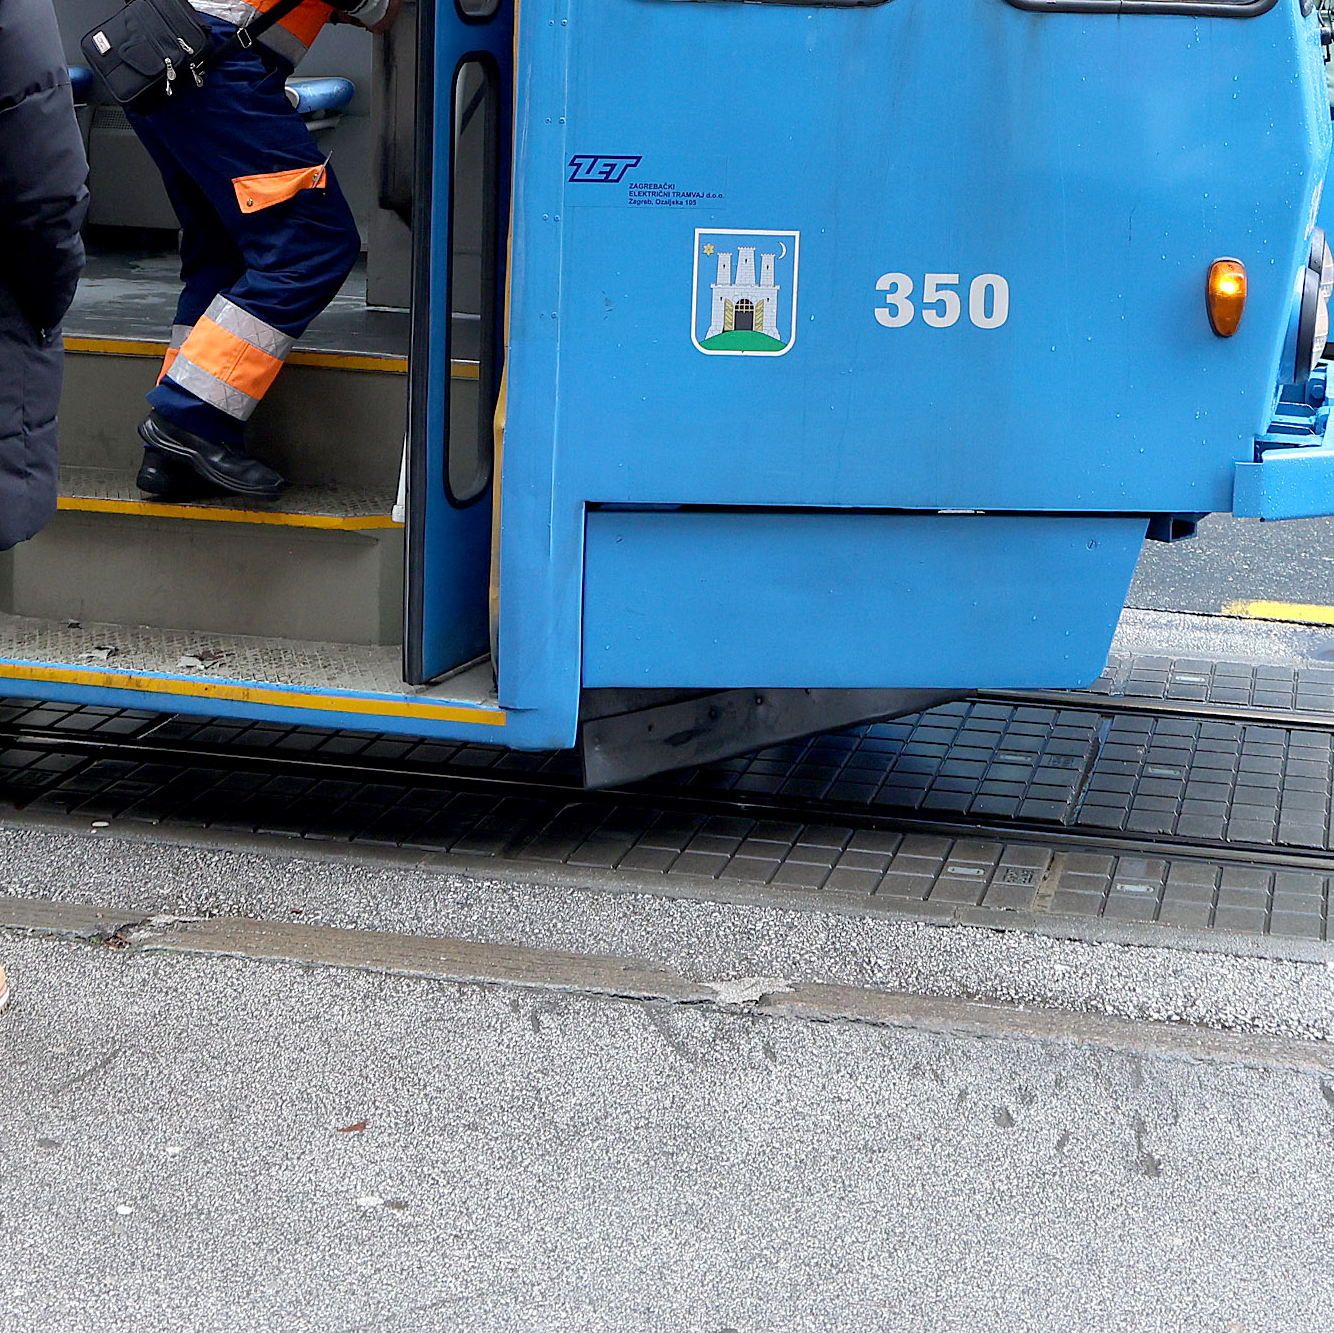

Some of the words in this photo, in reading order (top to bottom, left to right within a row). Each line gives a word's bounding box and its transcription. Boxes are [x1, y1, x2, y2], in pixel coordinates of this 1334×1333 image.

[568, 154, 643, 183] ZET
[628, 182, 676, 190] ZAGREBAČKI
[628, 190, 672, 198] ELEKTRIČNI
[672, 191, 705, 199] TRAMVAJ
[874, 272, 1010, 329] 350
